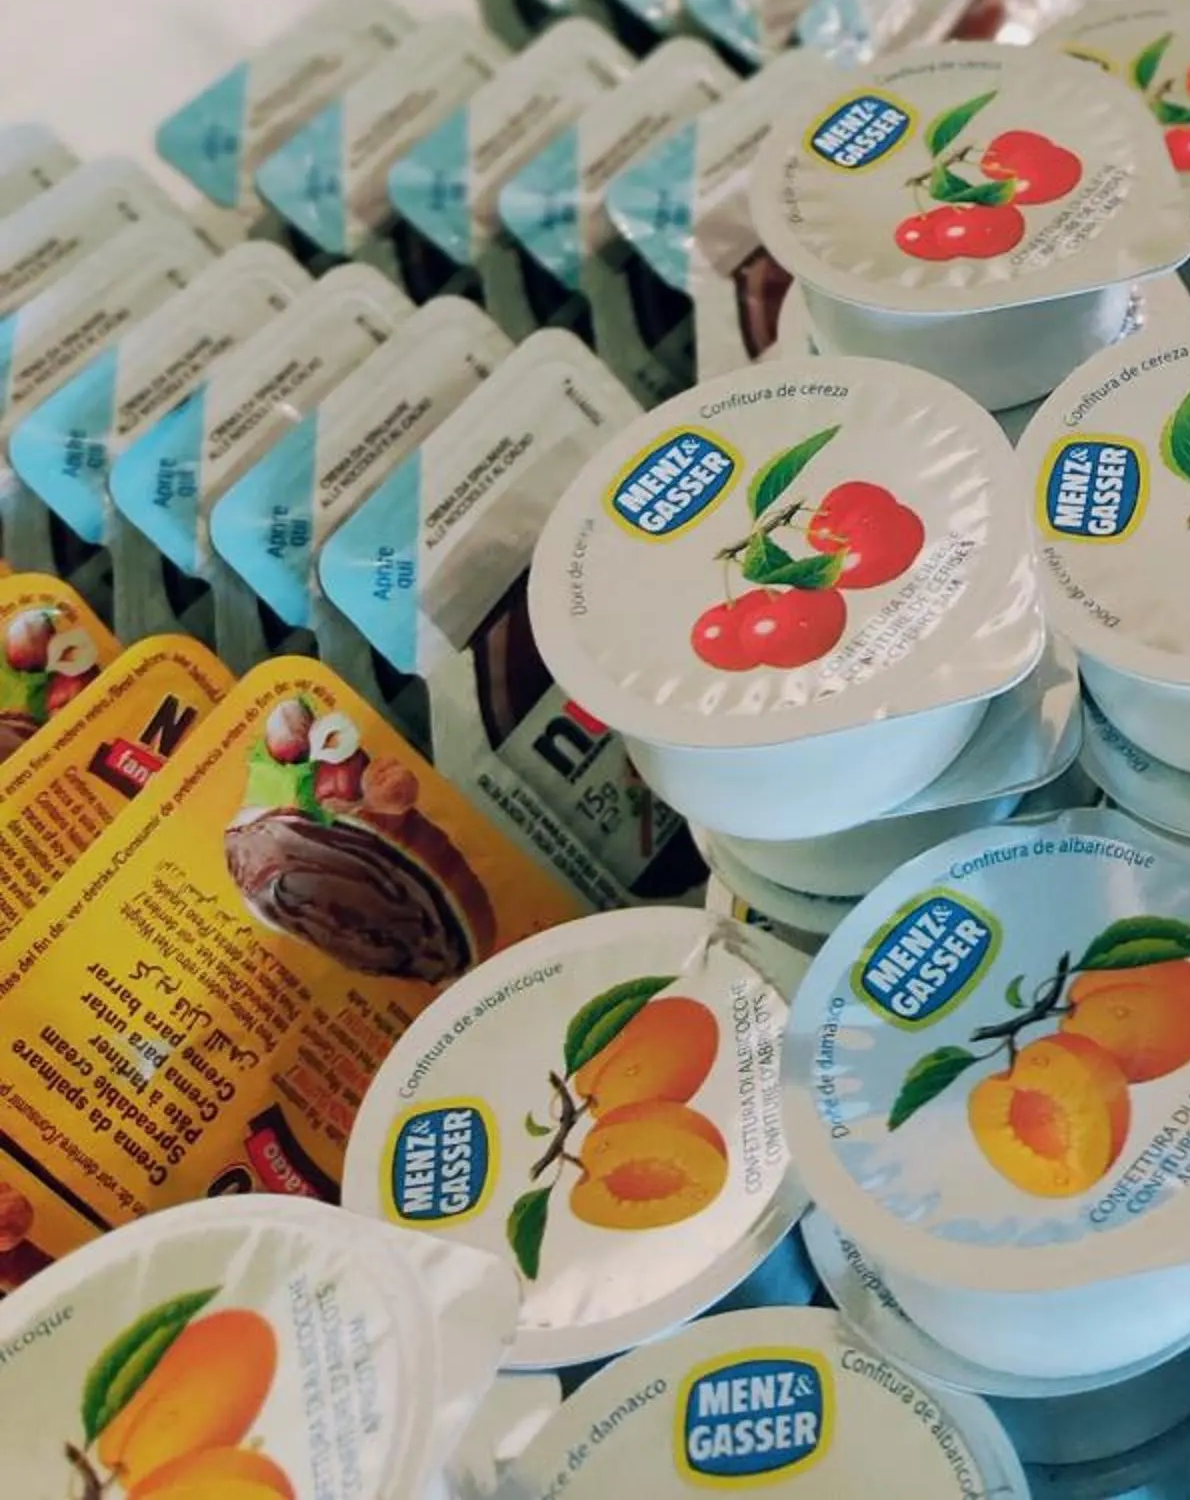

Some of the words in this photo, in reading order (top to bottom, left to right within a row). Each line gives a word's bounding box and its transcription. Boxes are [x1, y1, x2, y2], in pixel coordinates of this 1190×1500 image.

[834, 109, 907, 167] GASSER
[700, 388, 773, 419] Confitura
[776, 382, 797, 398] de
[800, 384, 849, 398] cereza
[1064, 377, 1122, 427] Confitura
[1120, 366, 1139, 383] de
[1141, 346, 1190, 372] cereza
[638, 450, 731, 533] GASSER
[1087, 448, 1129, 536] GASSER
[948, 844, 1031, 881] Confitura
[1033, 838, 1055, 857] de
[1058, 838, 1157, 870] albaricoque
[81, 959, 143, 1015] barrar
[890, 918, 988, 1018] GASSER
[77, 989, 128, 1035] untar
[141, 1007, 185, 1048] para
[399, 1031, 455, 1100] Confitura
[453, 1013, 474, 1035] de
[474, 960, 564, 1018] albaricoque
[6, 1036, 92, 1113] spalmare
[37, 1024, 95, 1077] cream
[82, 1032, 151, 1094] tartiner
[125, 1029, 168, 1069] para
[174, 1044, 239, 1103] Creme
[145, 1089, 163, 1107] à
[158, 1066, 221, 1124] Crema
[816, 1074, 836, 1096] de
[83, 1107, 113, 1136] da
[85, 1073, 190, 1166] Spreadable
[158, 1101, 204, 1144] Pâte
[106, 1128, 171, 1188] Crema
[440, 1108, 473, 1215] GASSER
[1089, 1125, 1179, 1224] CONFETTURA
[840, 1349, 915, 1405] Confitura
[913, 1400, 937, 1424] de
[567, 1443, 589, 1471] de
[590, 1378, 668, 1444] damasco
[688, 1412, 819, 1463] GASSER
